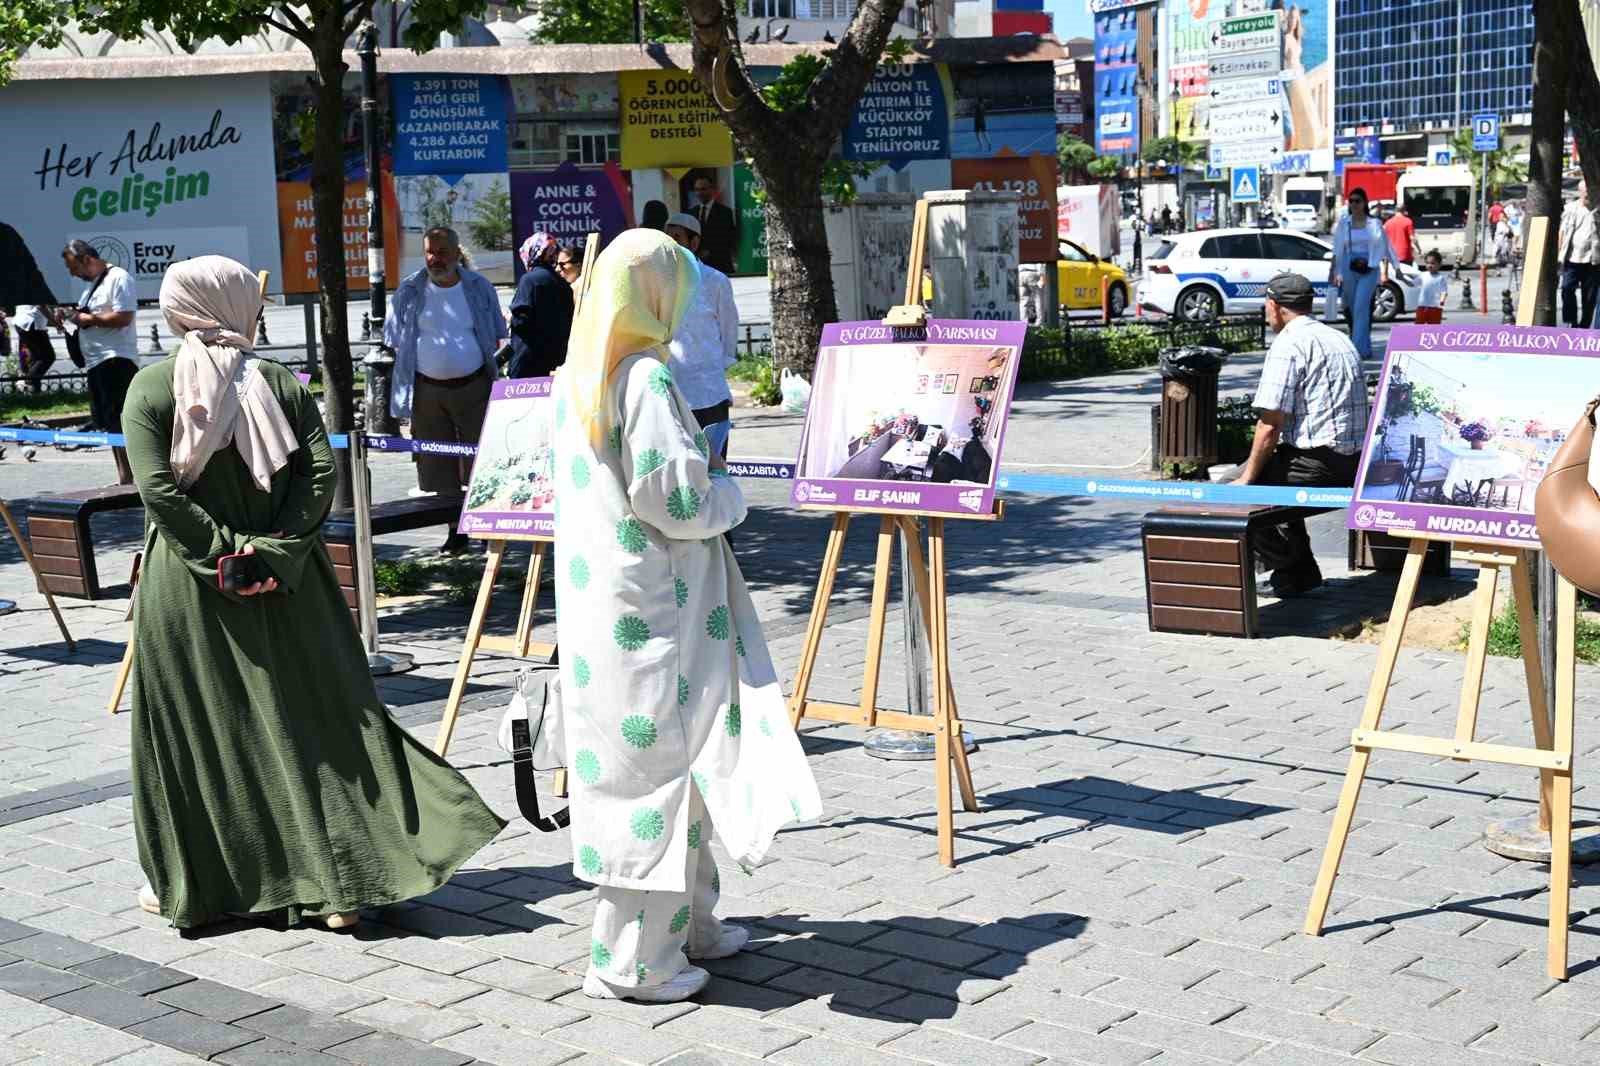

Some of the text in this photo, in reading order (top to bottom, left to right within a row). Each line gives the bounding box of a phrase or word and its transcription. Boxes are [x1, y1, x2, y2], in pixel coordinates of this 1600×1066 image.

[413, 79, 479, 91] 3.391 TON
[646, 79, 701, 95] 5.000
[916, 80, 930, 91] TL
[414, 89, 480, 105] ATIĞI GERİ
[915, 93, 932, 106] İLE
[410, 105, 486, 120] DÖNÜŞÜME
[858, 108, 933, 126] KÜÇÜKKÖY
[398, 121, 499, 133] KAZANDIRARAK
[650, 125, 702, 139] DESTEĞİ
[1479, 120, 1492, 135] D
[410, 132, 488, 147] 4.286 AĞACI
[853, 138, 940, 153] YENİLİYORUZ
[34, 109, 242, 191] Her Adımda
[414, 148, 486, 160] KURTARDIK
[72, 166, 210, 222] Gelişim
[534, 184, 597, 199] ANNE &
[538, 201, 594, 219] ÇOCUK
[533, 215, 602, 233] ETKİNLİK
[133, 242, 176, 260] Eray
[1419, 332, 1441, 349] EN
[1443, 330, 1494, 348] GÜZEL
[1497, 332, 1561, 351] BALKON
[1427, 514, 1502, 536] NURDAN
